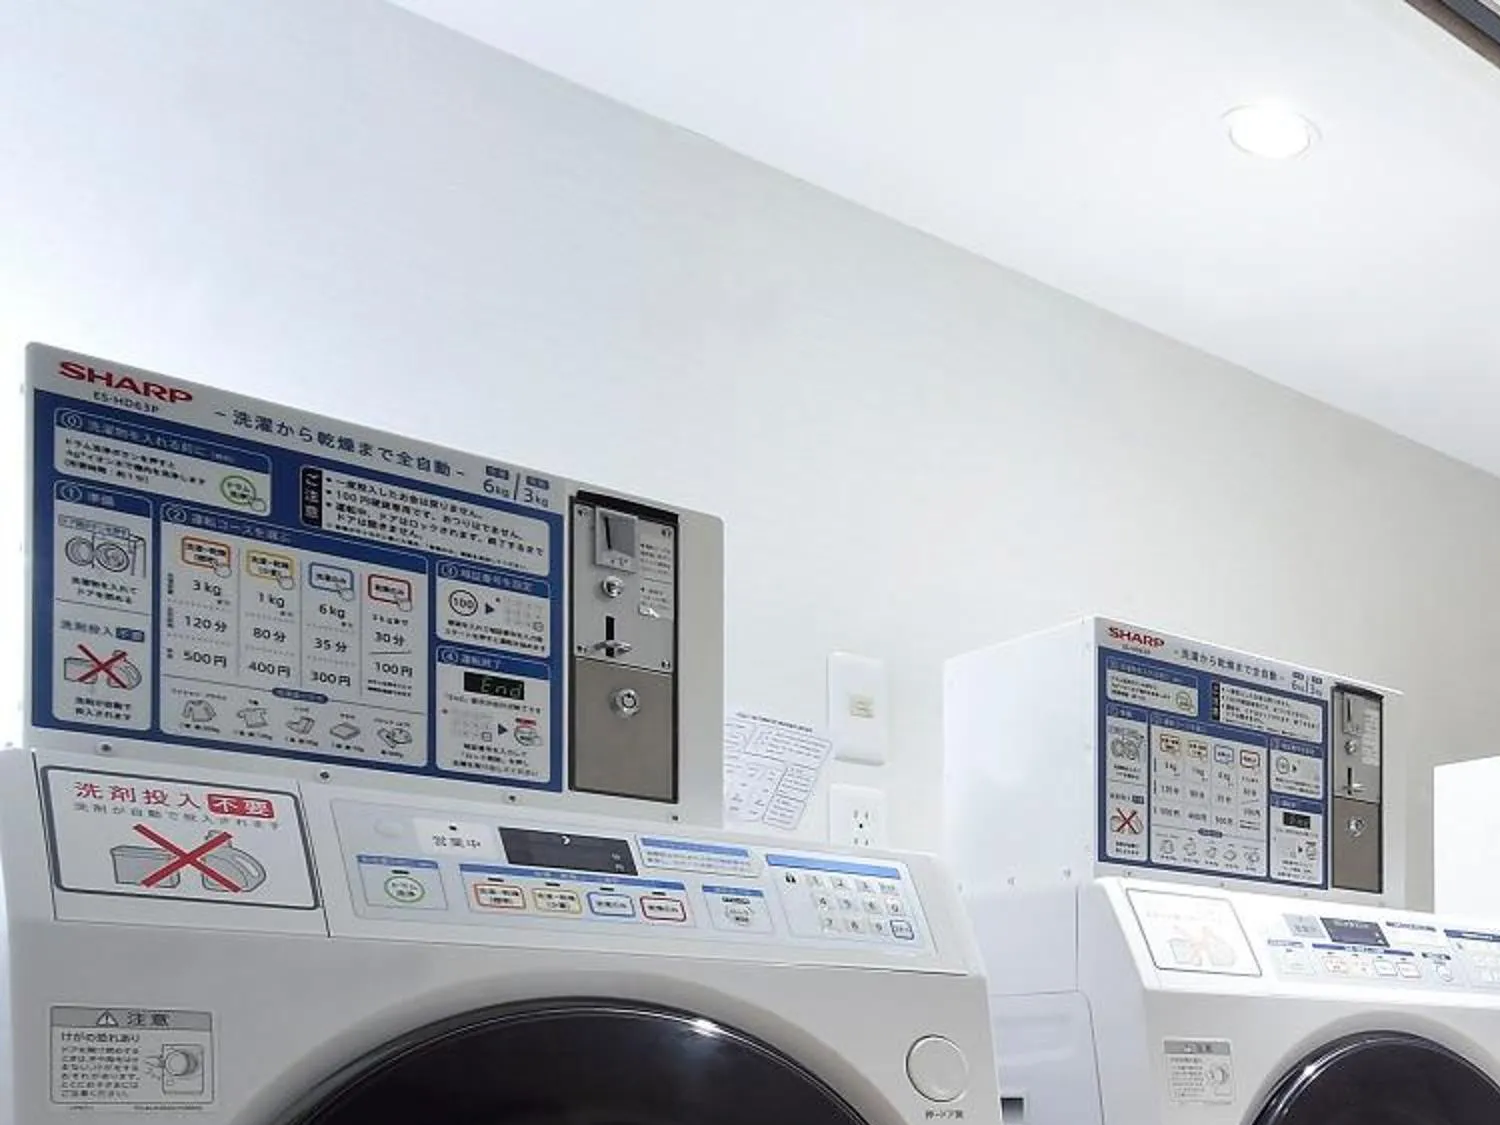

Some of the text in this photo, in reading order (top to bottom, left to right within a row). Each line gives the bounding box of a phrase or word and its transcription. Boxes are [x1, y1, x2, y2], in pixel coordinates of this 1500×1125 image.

[58, 360, 193, 403] SHARP
[1108, 626, 1165, 648] SHARP
[73, 780, 200, 809] 洗剤投入
